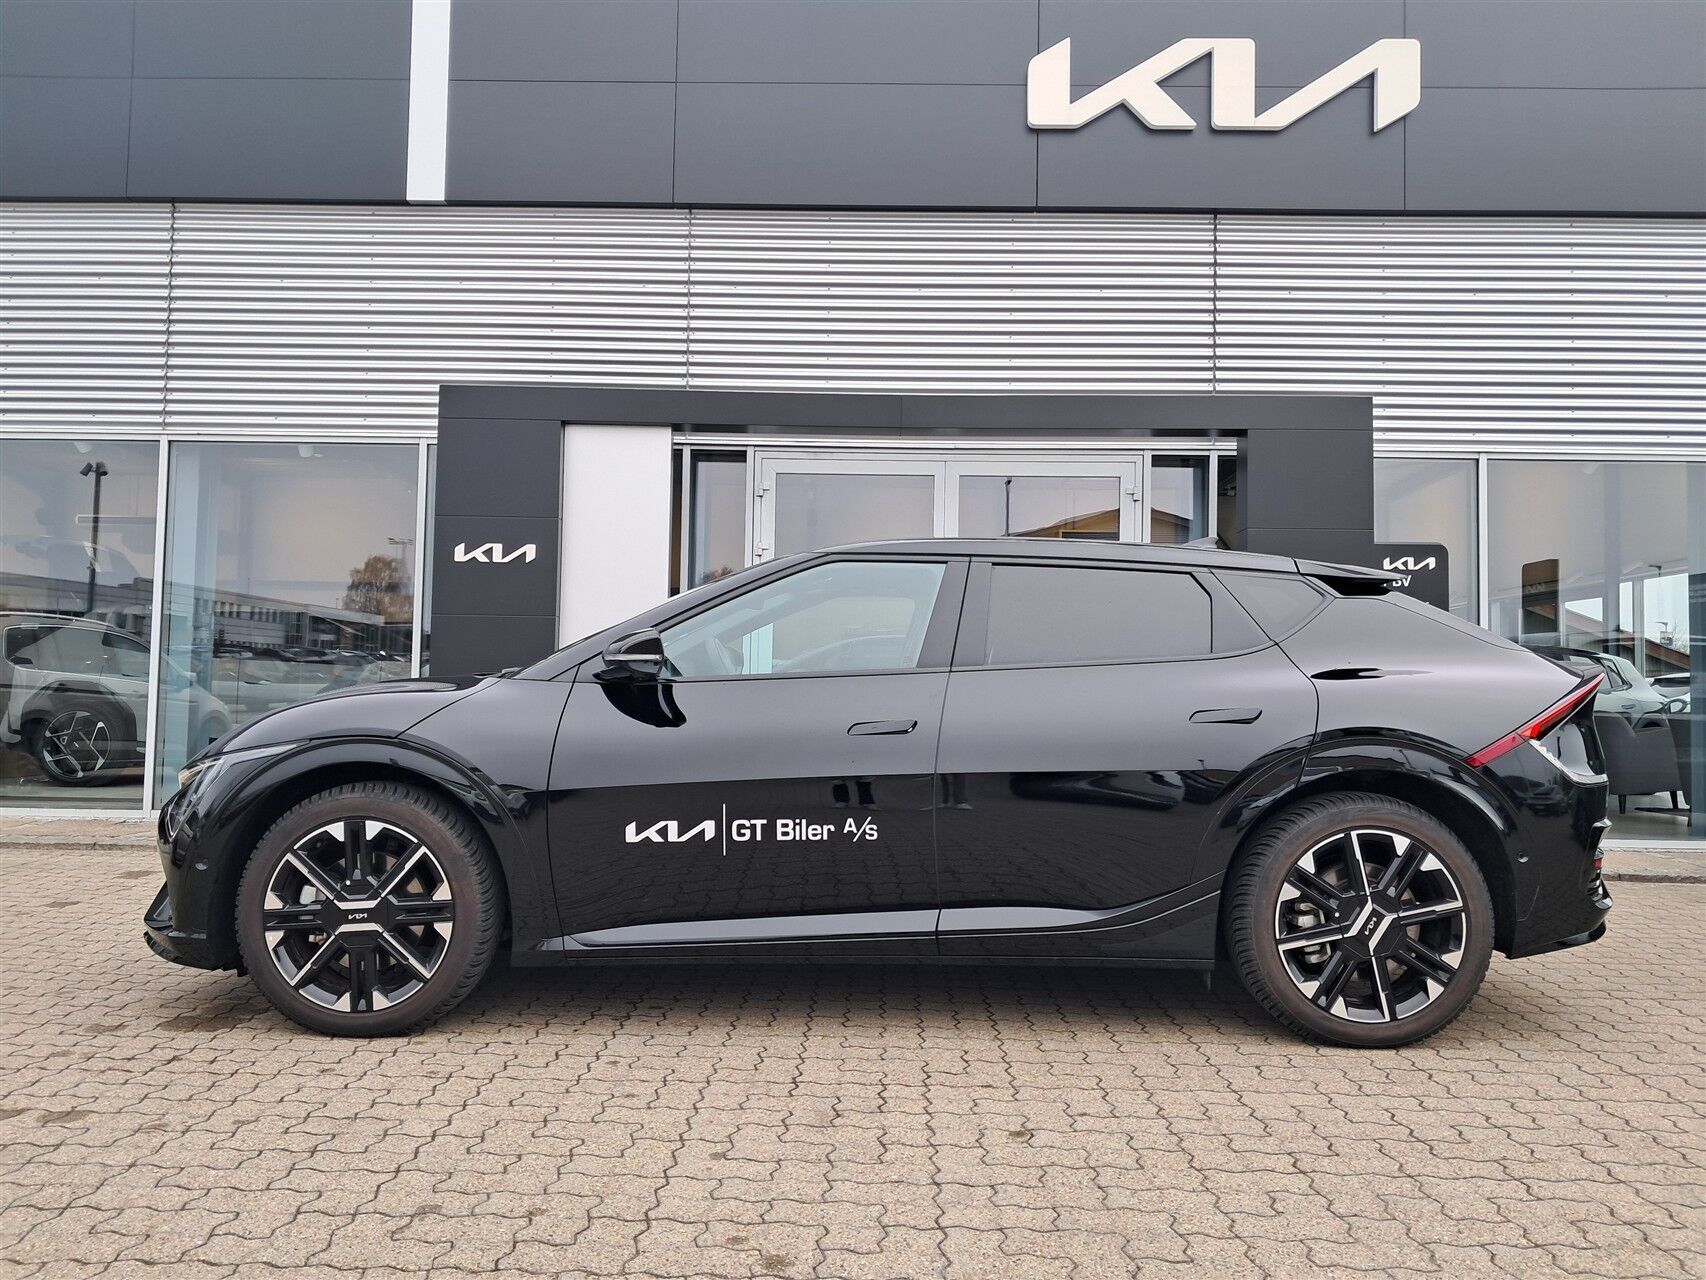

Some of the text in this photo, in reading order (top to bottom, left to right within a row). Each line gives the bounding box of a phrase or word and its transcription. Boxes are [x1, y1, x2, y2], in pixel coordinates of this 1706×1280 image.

[1027, 37, 1421, 133] KIA
[454, 542, 536, 563] KIA
[1382, 556, 1436, 570] KIA
[625, 820, 716, 843] KIA
[731, 819, 767, 842] GT
[776, 818, 835, 841] Biler
